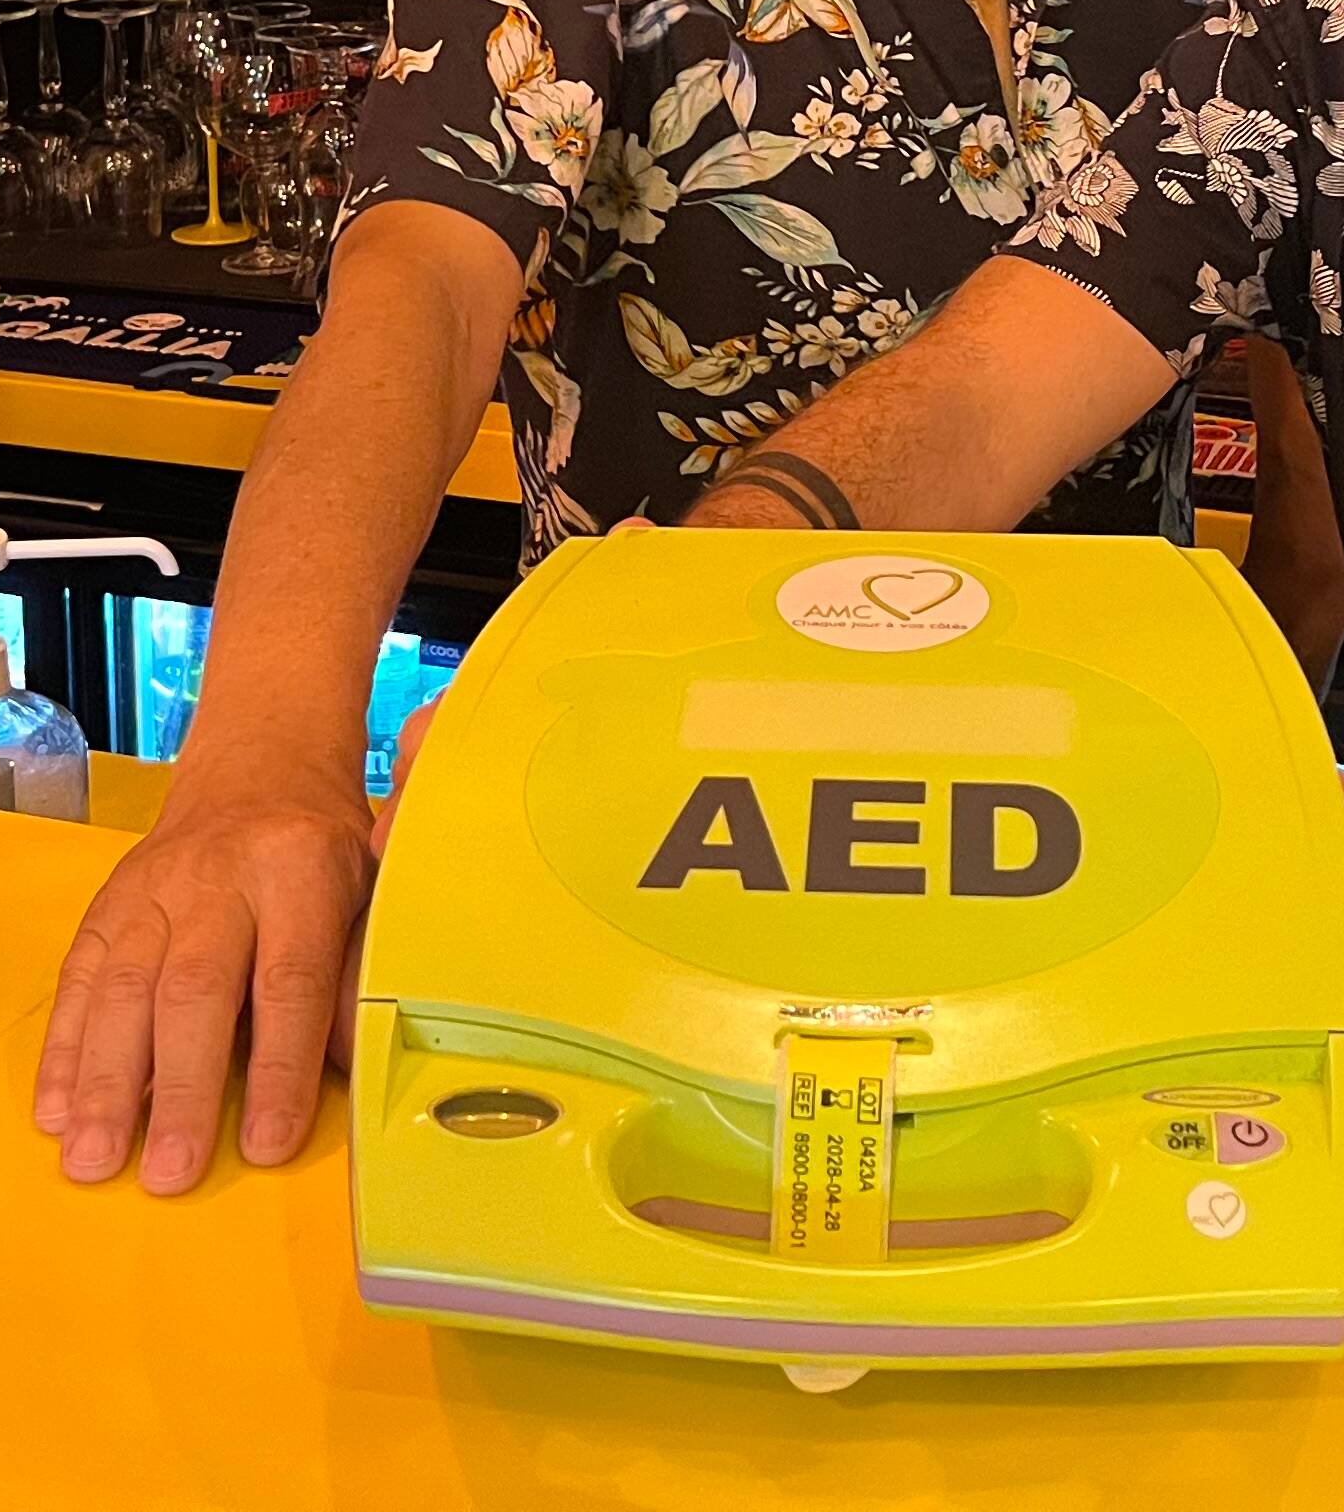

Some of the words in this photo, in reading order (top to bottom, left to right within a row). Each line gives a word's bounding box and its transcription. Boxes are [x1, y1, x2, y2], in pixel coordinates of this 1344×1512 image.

[791, 618, 847, 629] Chaque
[851, 620, 882, 630] jour
[886, 620, 895, 629] à
[900, 622, 924, 630] vos
[929, 621, 969, 630] côtés
[803, 603, 873, 620] AMC
[636, 774, 1083, 898] AED
[793, 1076, 812, 1117] REF
[860, 1079, 878, 1119] LOT
[1167, 1136, 1207, 1150] OFF
[1169, 1121, 1199, 1134] ON
[824, 1134, 844, 1232] 2028-04-28
[859, 1136, 878, 1193] 0423A
[789, 1130, 812, 1249] 8900-0800-01
